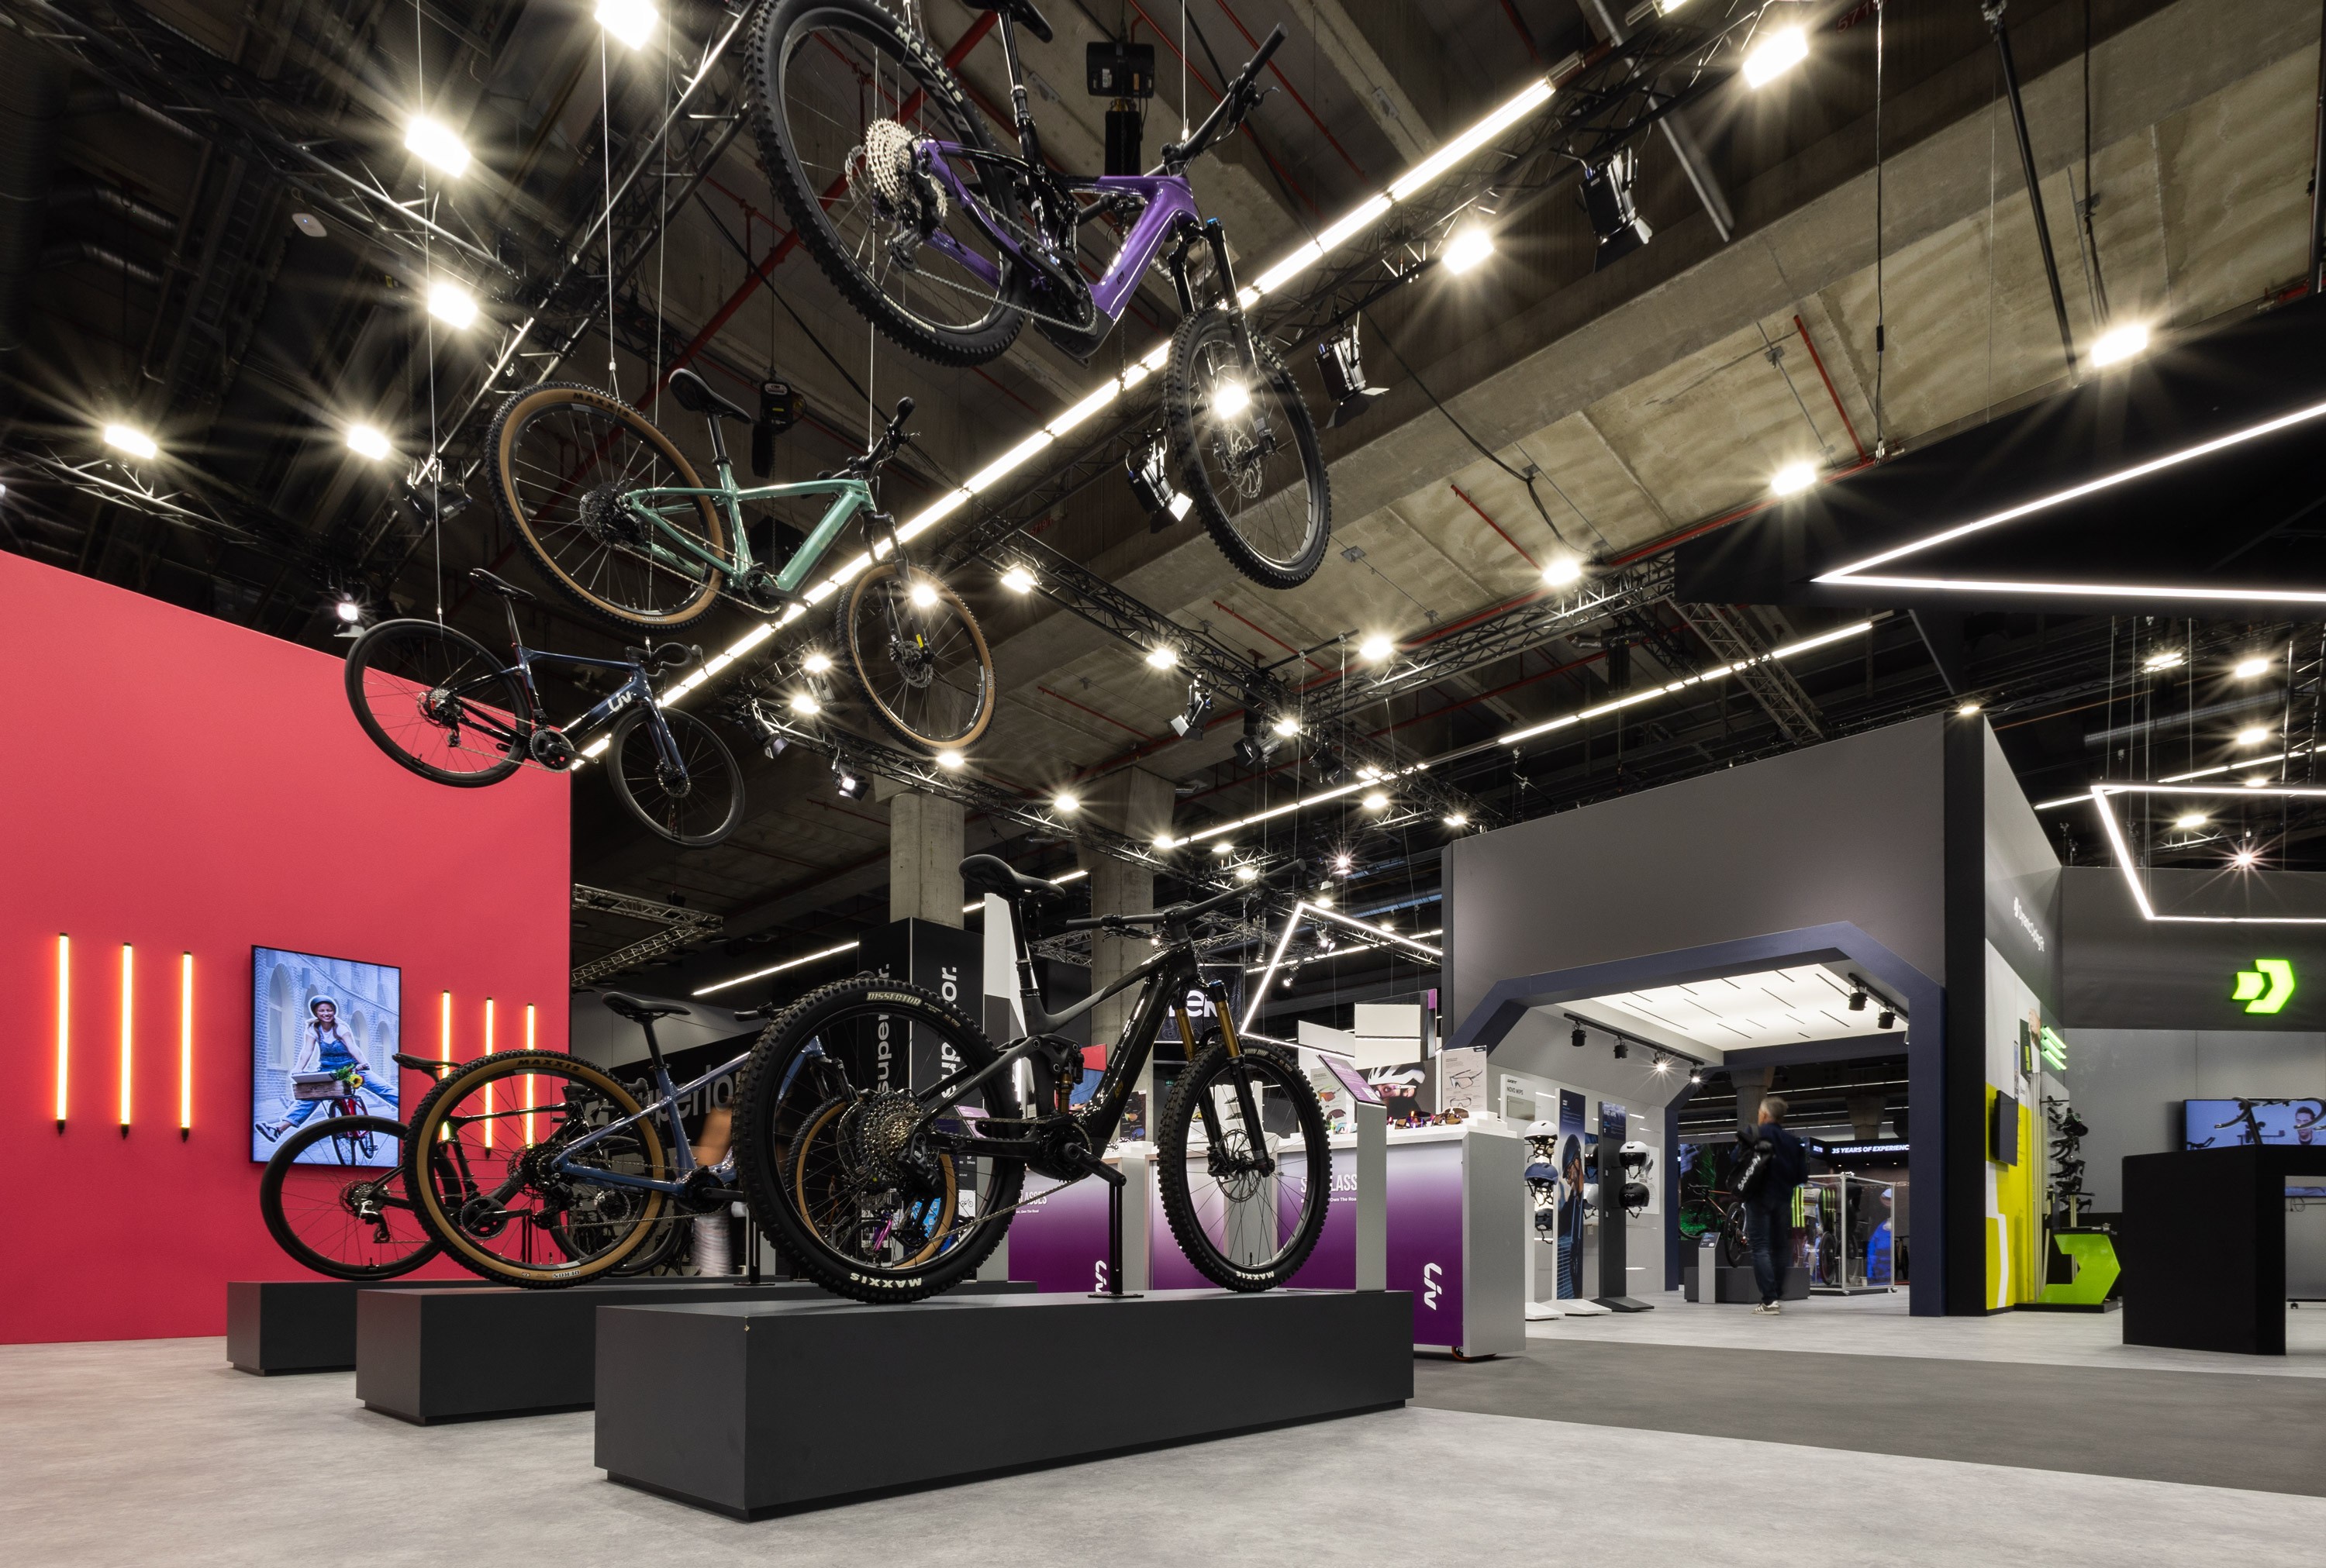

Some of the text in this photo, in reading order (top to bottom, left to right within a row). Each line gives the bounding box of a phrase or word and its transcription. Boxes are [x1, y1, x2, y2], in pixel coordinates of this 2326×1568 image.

[894, 26, 964, 102] MAXXIS
[573, 392, 631, 418] MAXXIS
[607, 691, 633, 712] Liv
[866, 992, 923, 1007] DISSECTOR
[517, 1059, 581, 1071] MAXXIS
[1872, 1144, 1910, 1153] EXPERIENC
[849, 1272, 923, 1288] MAXXIS
[1235, 1270, 1275, 1280] MAXXIS
[1424, 1262, 1442, 1311] Liv
